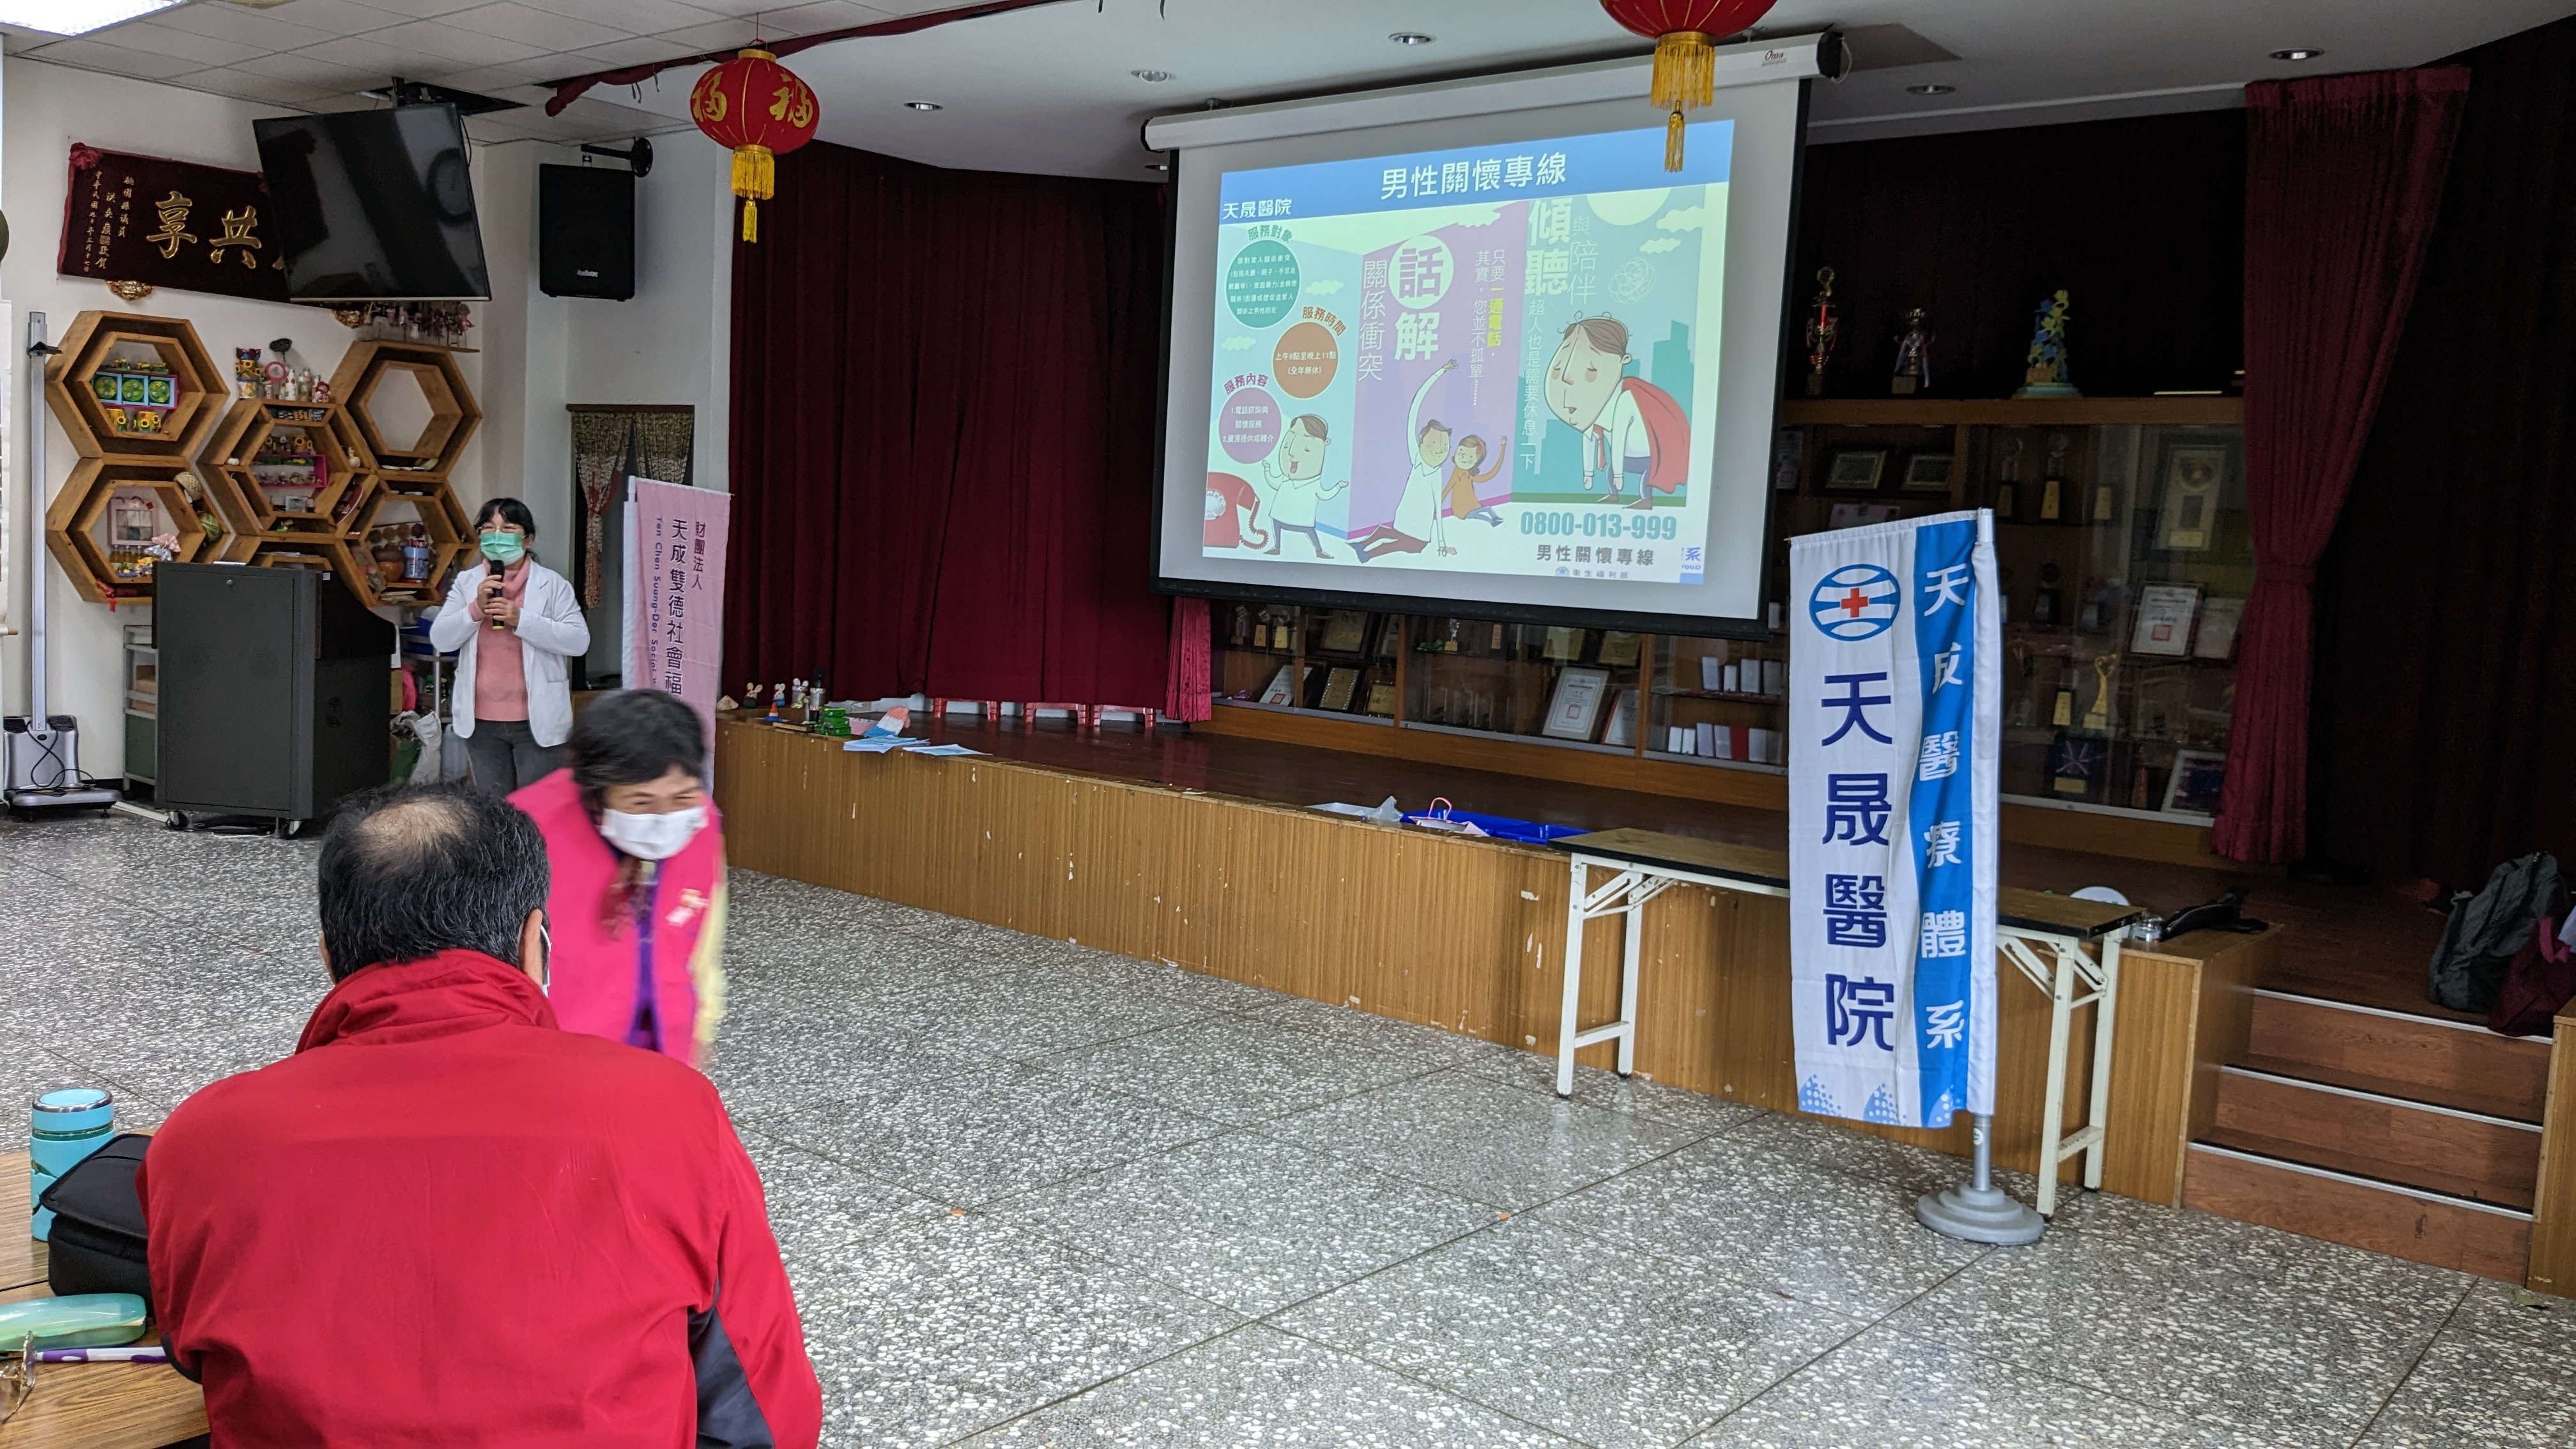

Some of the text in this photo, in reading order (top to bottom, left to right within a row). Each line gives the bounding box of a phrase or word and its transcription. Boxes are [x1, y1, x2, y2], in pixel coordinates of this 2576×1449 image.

[1381, 152, 1566, 200] 男性關懷專線
[1222, 198, 1292, 220] 天晟醫院
[146, 190, 285, 270] 共享
[1248, 225, 1292, 243] 服務對象
[1524, 198, 1572, 296] 傾聽
[1567, 217, 1598, 305] 與陪伴
[1303, 307, 1346, 336] 服務時間
[1358, 261, 1387, 381] 關係衝突
[1395, 246, 1444, 361] 話解
[1275, 351, 1337, 361] 上午9點至晚上11點
[1288, 366, 1321, 376] (全年無休)
[1223, 372, 1268, 395] 服務內容
[1520, 300, 1544, 470] 超人也是需要休息一下
[1520, 511, 1676, 540] 0800-013-999
[654, 542, 663, 570] Chen
[692, 521, 707, 590] 財團法人
[1437, 548, 1447, 556] 10
[1537, 544, 1654, 567] 男性關懷專線
[1681, 546, 1701, 561] 系
[651, 576, 661, 633] Suang-Der
[664, 519, 688, 701] 天成雙德社會福
[1821, 671, 1894, 1052] 天晟醫院
